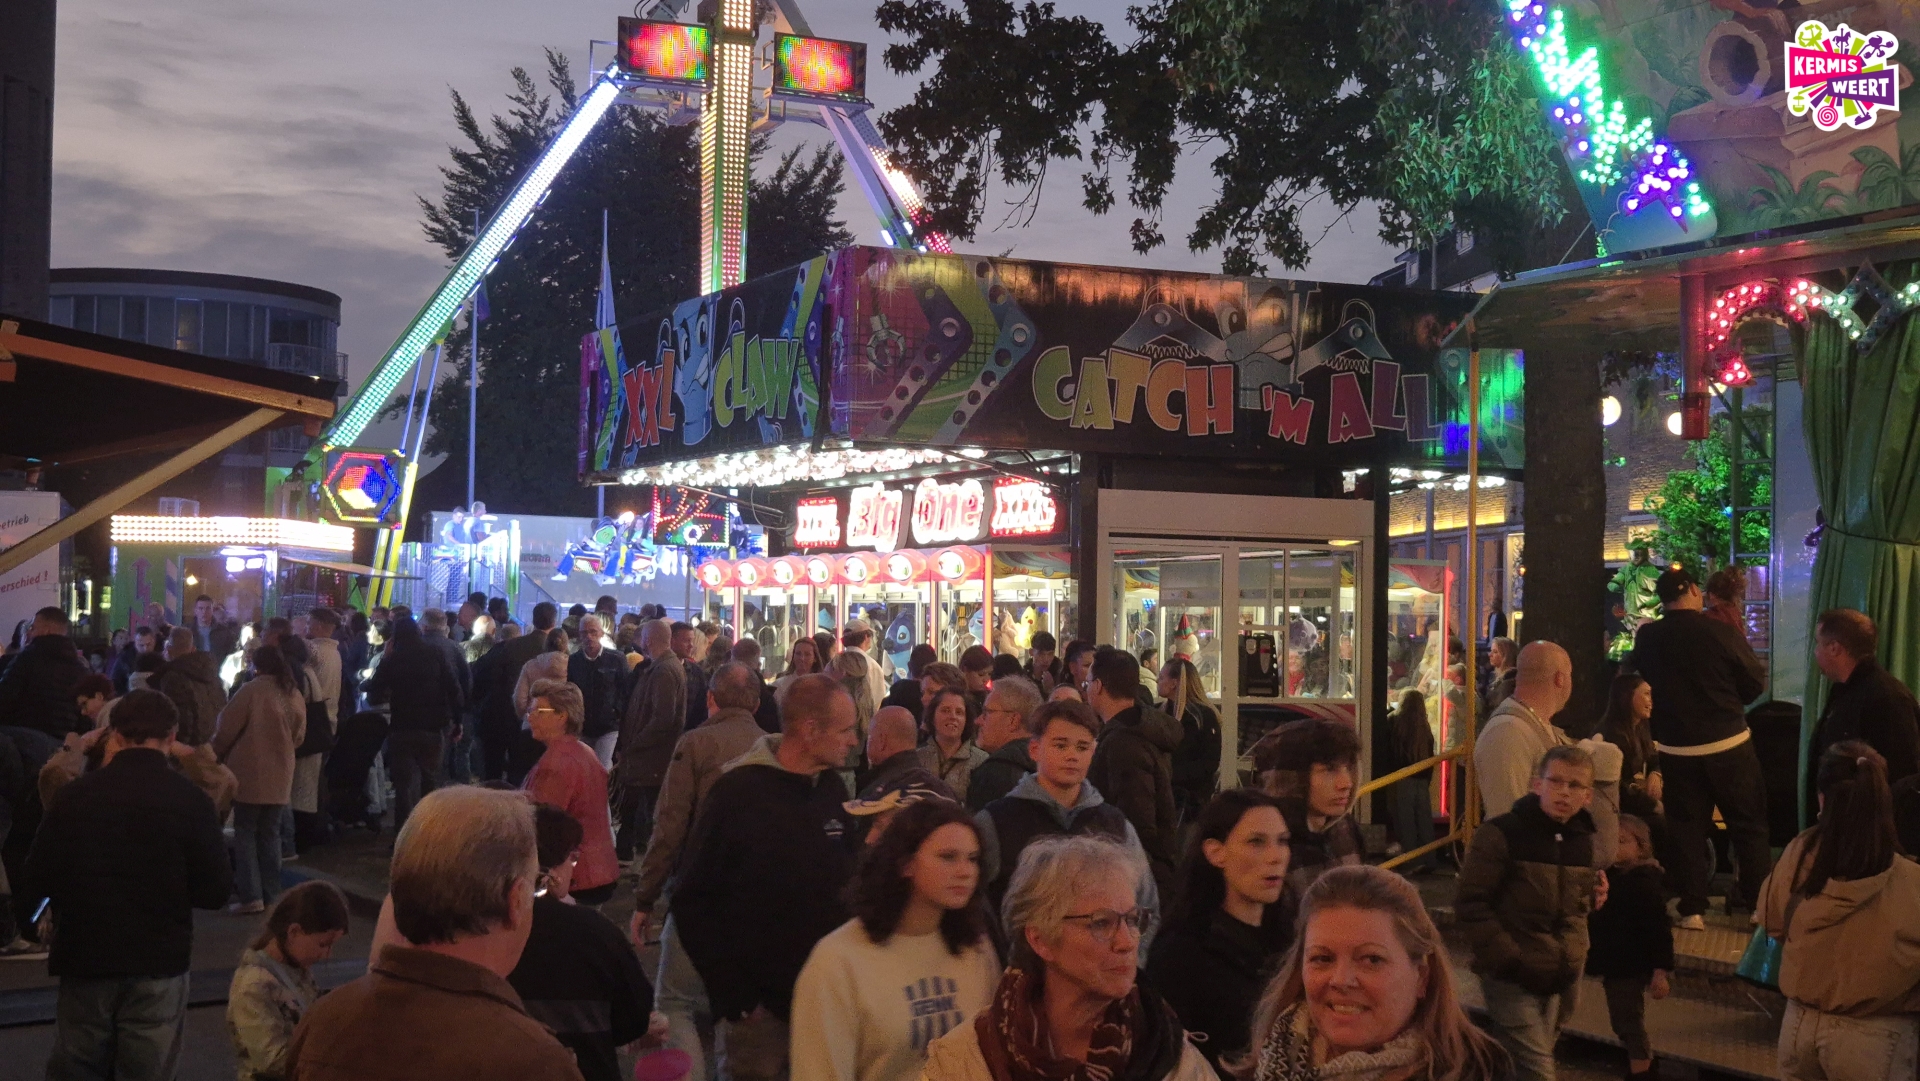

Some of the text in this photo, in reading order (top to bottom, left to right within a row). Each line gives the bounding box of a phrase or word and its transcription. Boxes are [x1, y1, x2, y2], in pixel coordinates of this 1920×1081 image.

[623, 330, 800, 448] XXL CLAW
[1032, 345, 1443, 446] CATCH 'M ALL
[0, 514, 30, 529] etrieb
